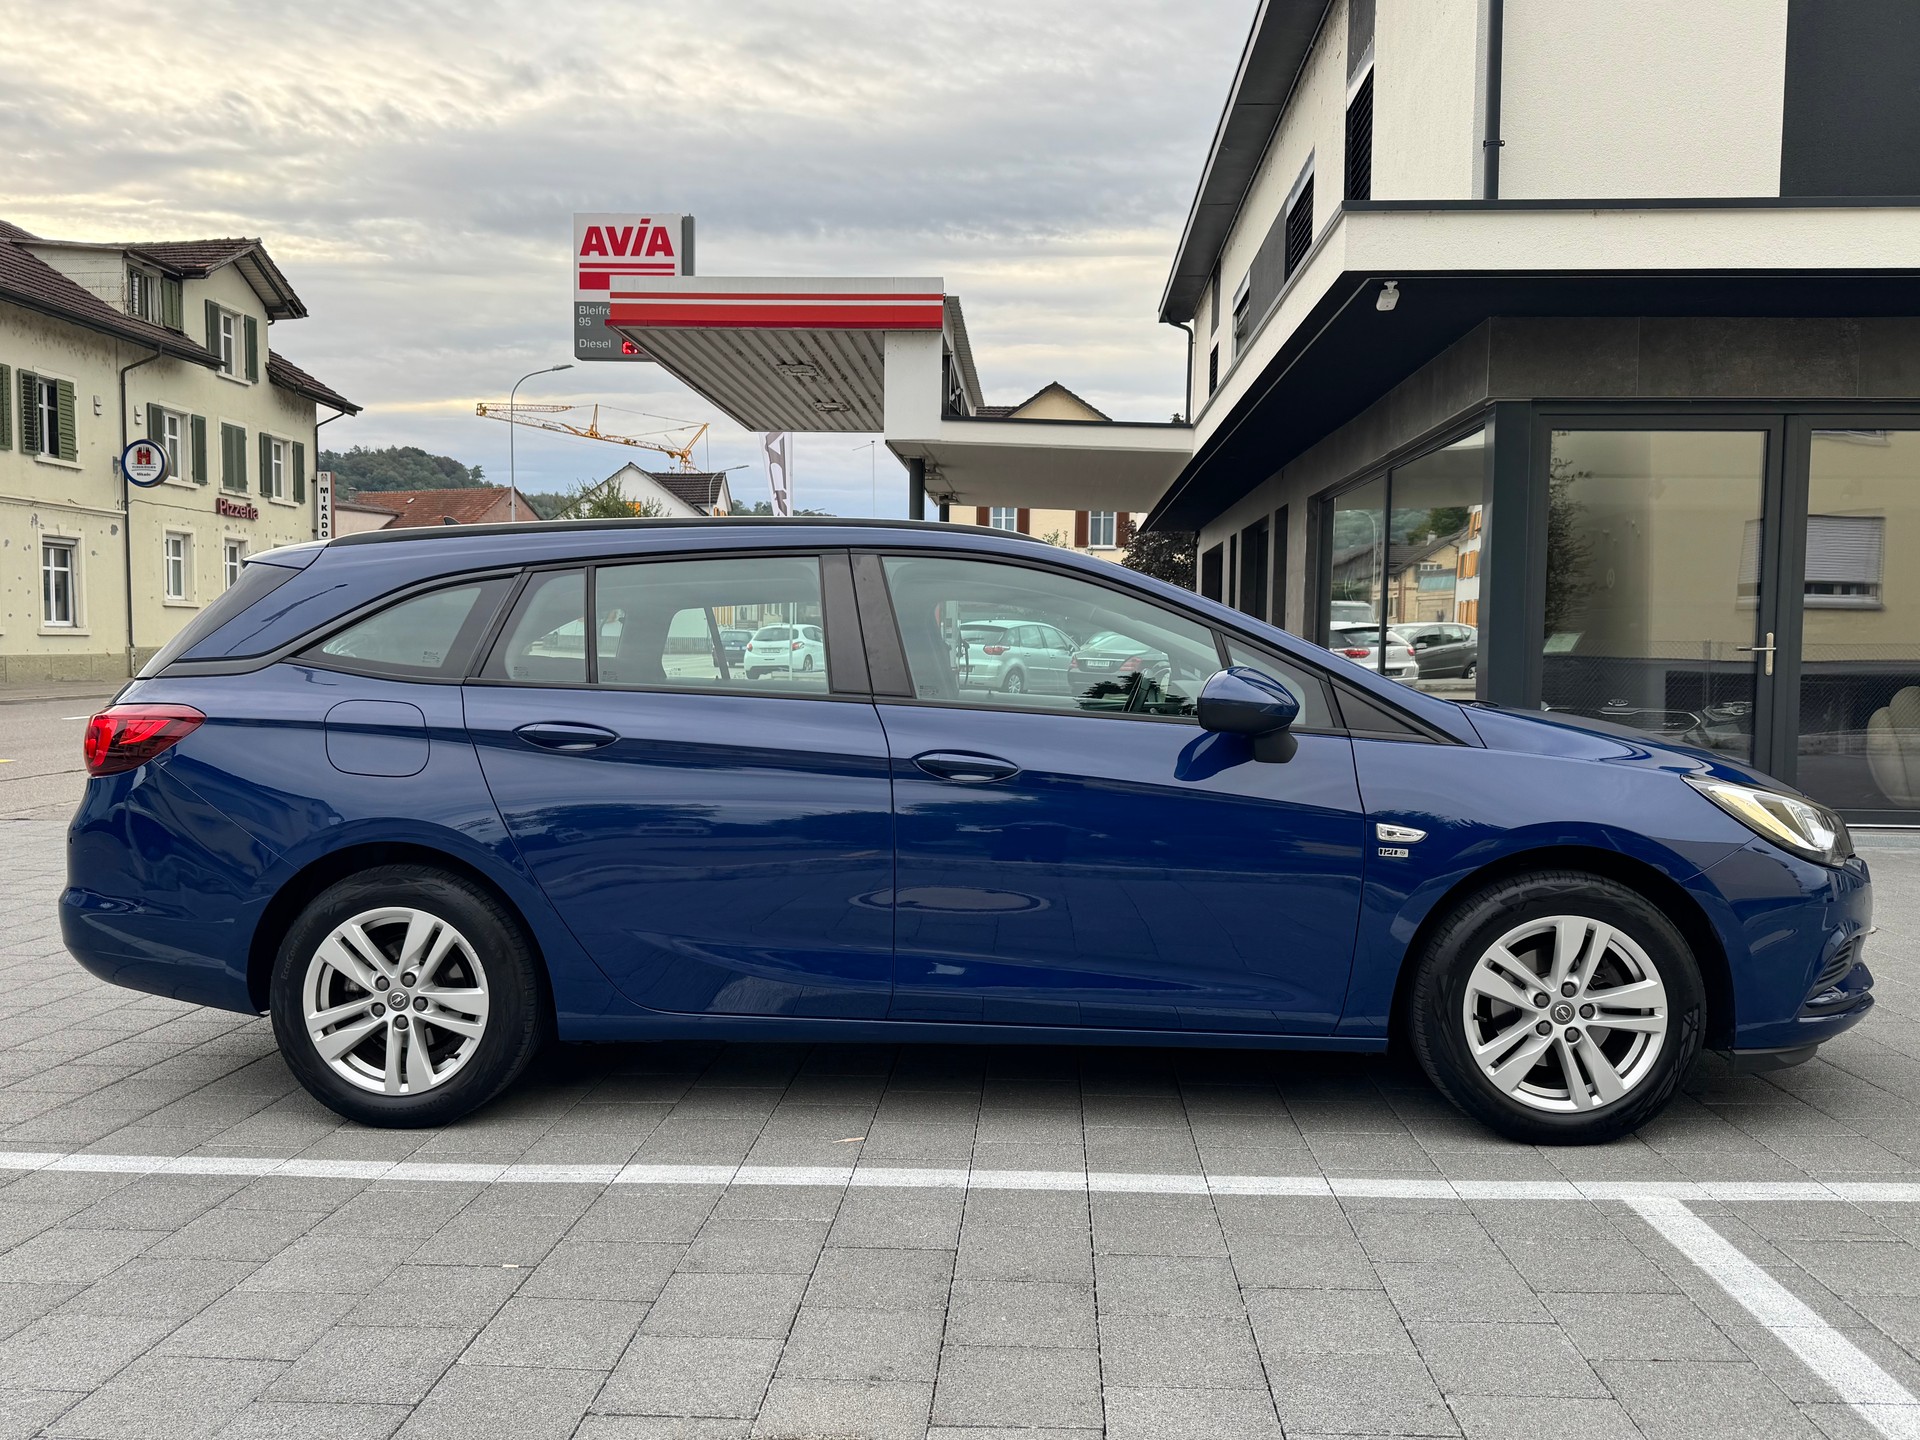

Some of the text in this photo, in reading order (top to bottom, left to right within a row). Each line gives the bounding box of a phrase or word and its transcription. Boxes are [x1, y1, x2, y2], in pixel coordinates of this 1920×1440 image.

[579, 305, 611, 315] Bleifre
[578, 316, 591, 326] 95
[579, 338, 611, 348] Diesel
[218, 498, 259, 520] Pizzeria
[320, 487, 329, 537] MIKADO
